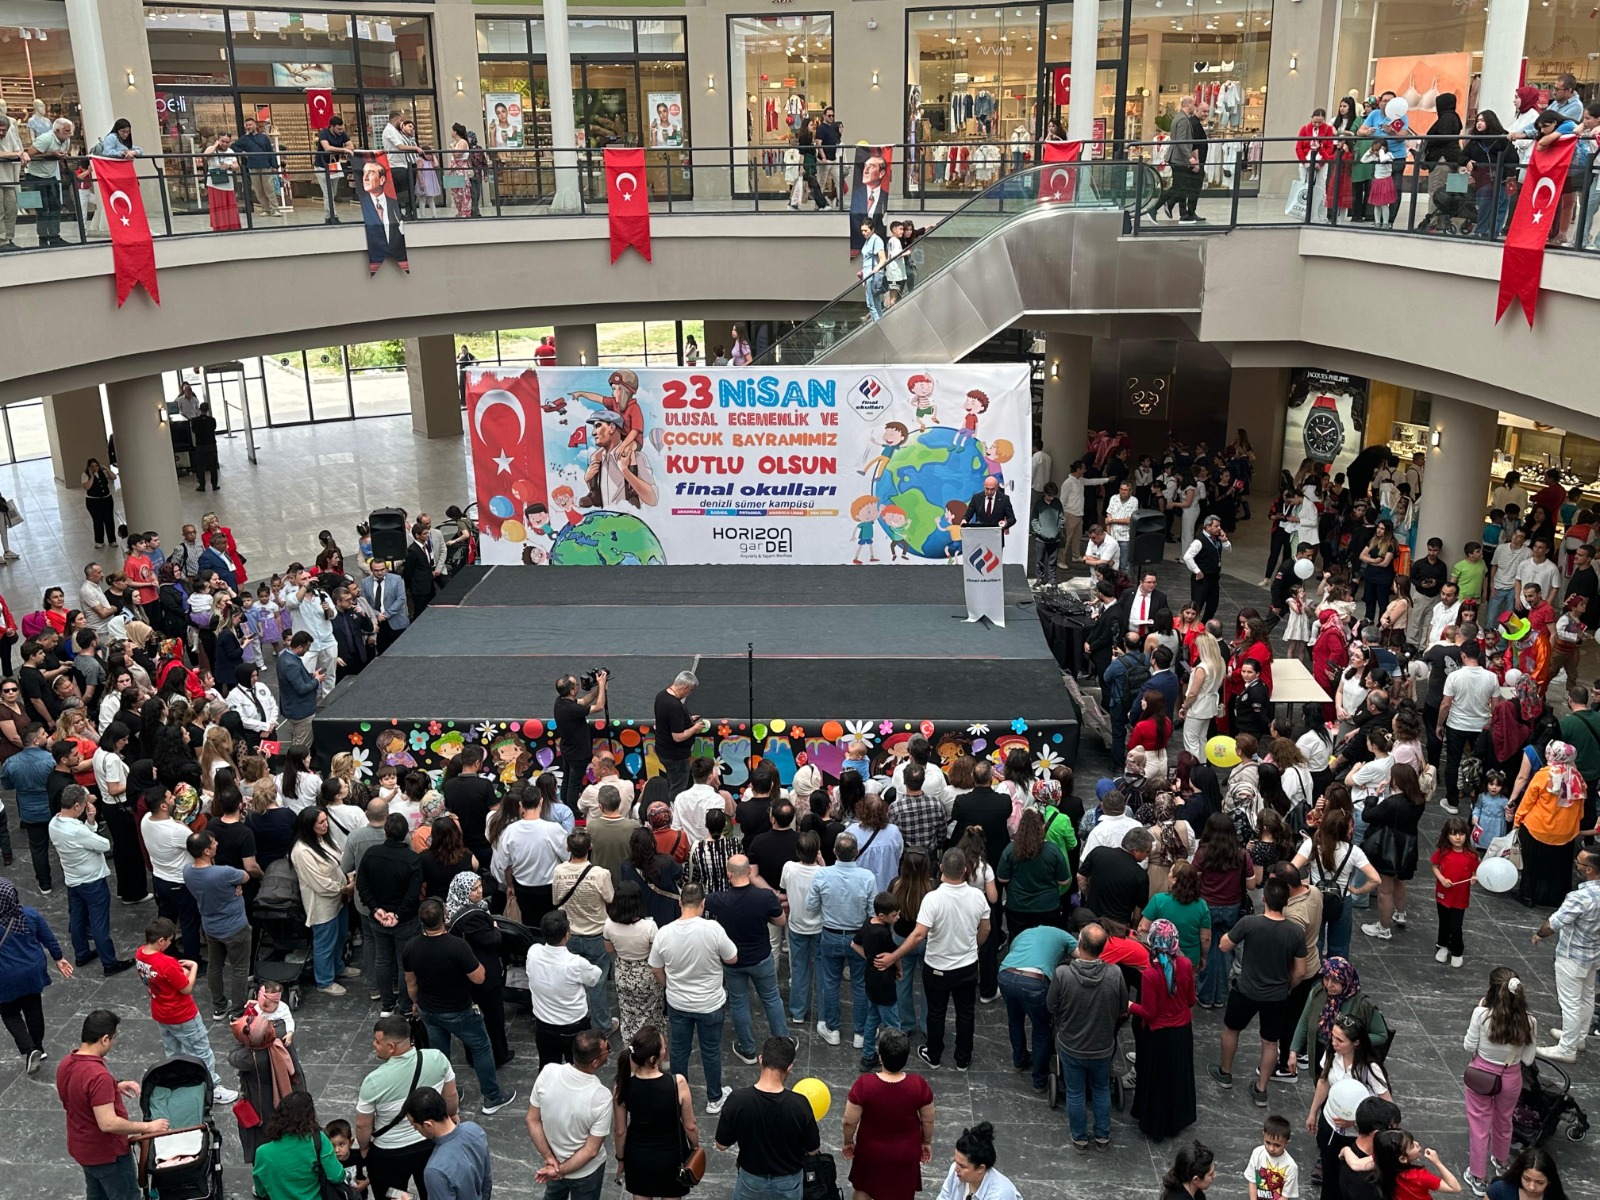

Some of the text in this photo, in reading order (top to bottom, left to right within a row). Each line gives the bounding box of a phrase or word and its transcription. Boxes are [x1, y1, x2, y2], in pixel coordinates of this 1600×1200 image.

[1539, 61, 1575, 74] ACTIVE
[1307, 371, 1328, 380] JACQUES
[1328, 374, 1350, 383] PHILIPPE
[662, 375, 714, 409] 23
[665, 409, 839, 426] ULUSAL EGEMENLİK VE
[663, 432, 838, 452] ÇOCUK BAYRAMIMIZ
[666, 454, 837, 475] KUTLU OLSUN
[675, 482, 837, 496] final okulları
[699, 499, 815, 510] denizli sümer kampüsü
